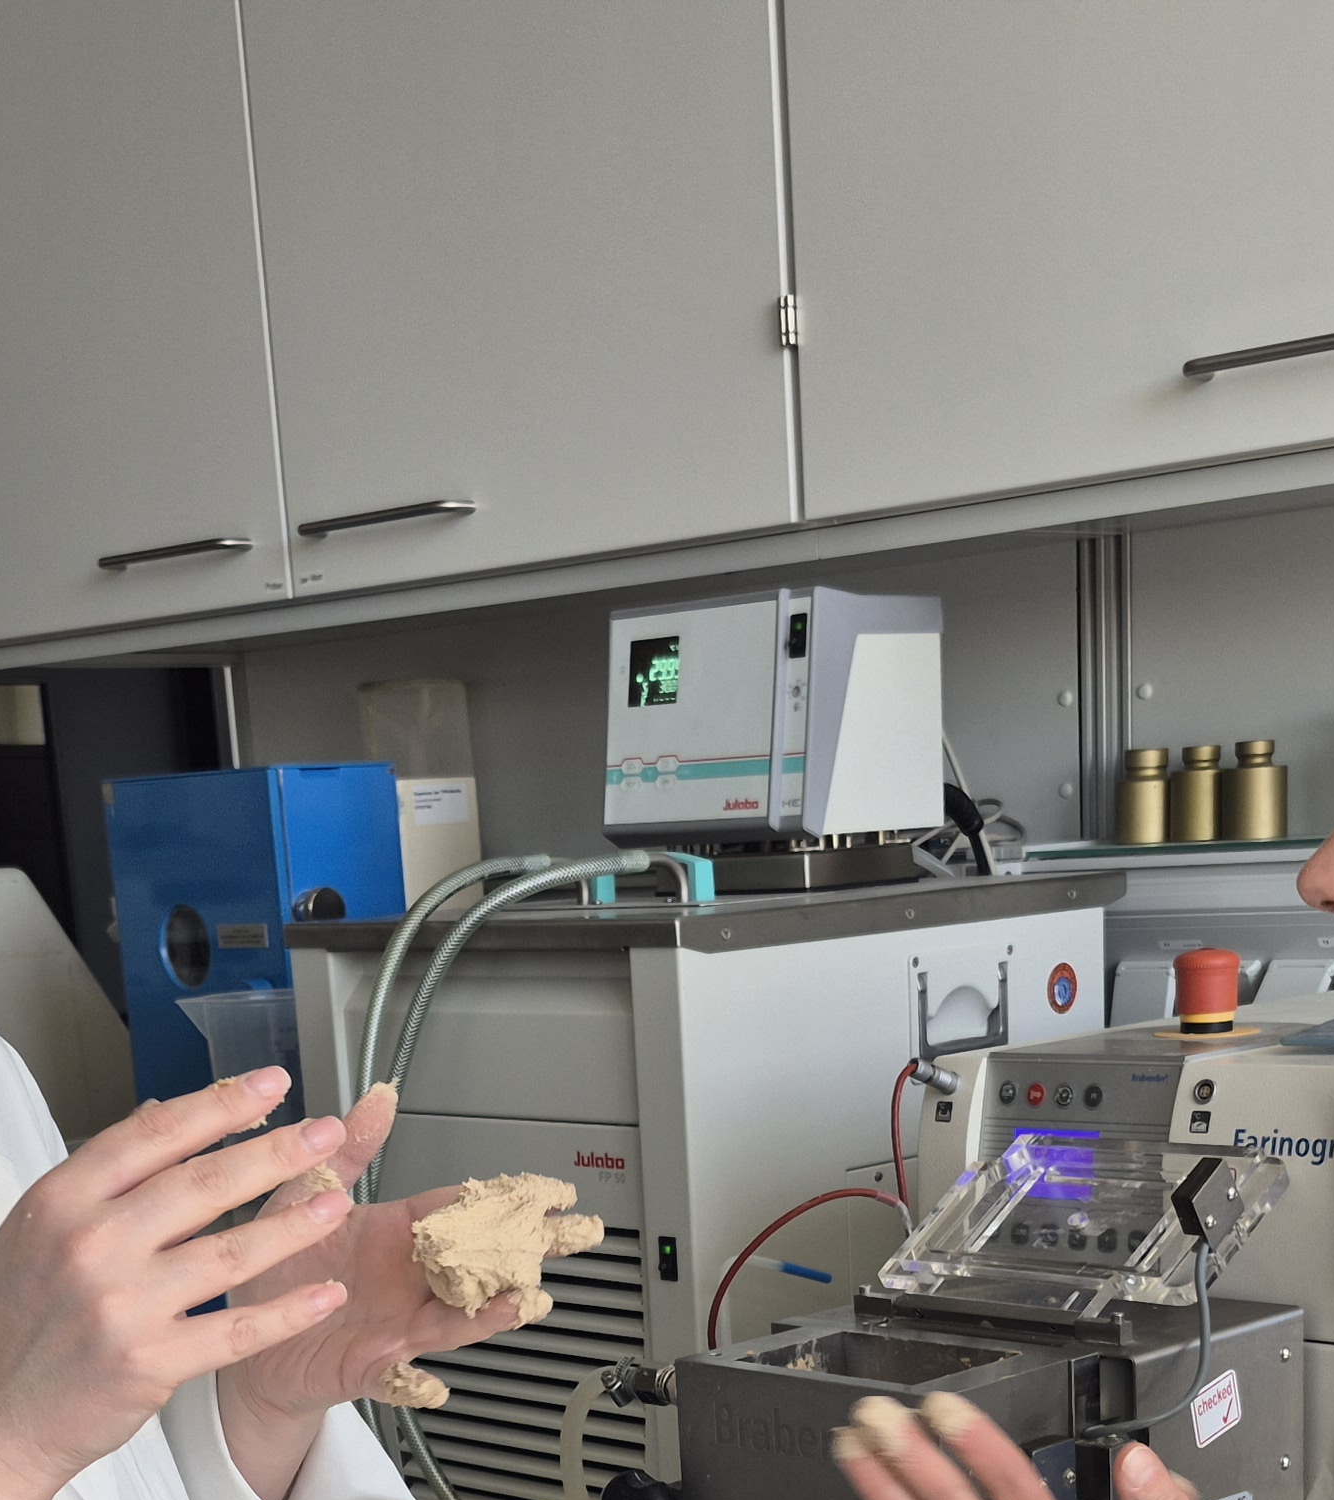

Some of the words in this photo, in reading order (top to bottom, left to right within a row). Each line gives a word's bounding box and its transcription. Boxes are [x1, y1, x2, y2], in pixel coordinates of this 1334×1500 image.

[723, 798, 760, 811] Julabo
[573, 1150, 625, 1170] Julabo
[598, 1171, 612, 1182] FP
[614, 1173, 626, 1185] 50
[1197, 1380, 1233, 1417] checked
